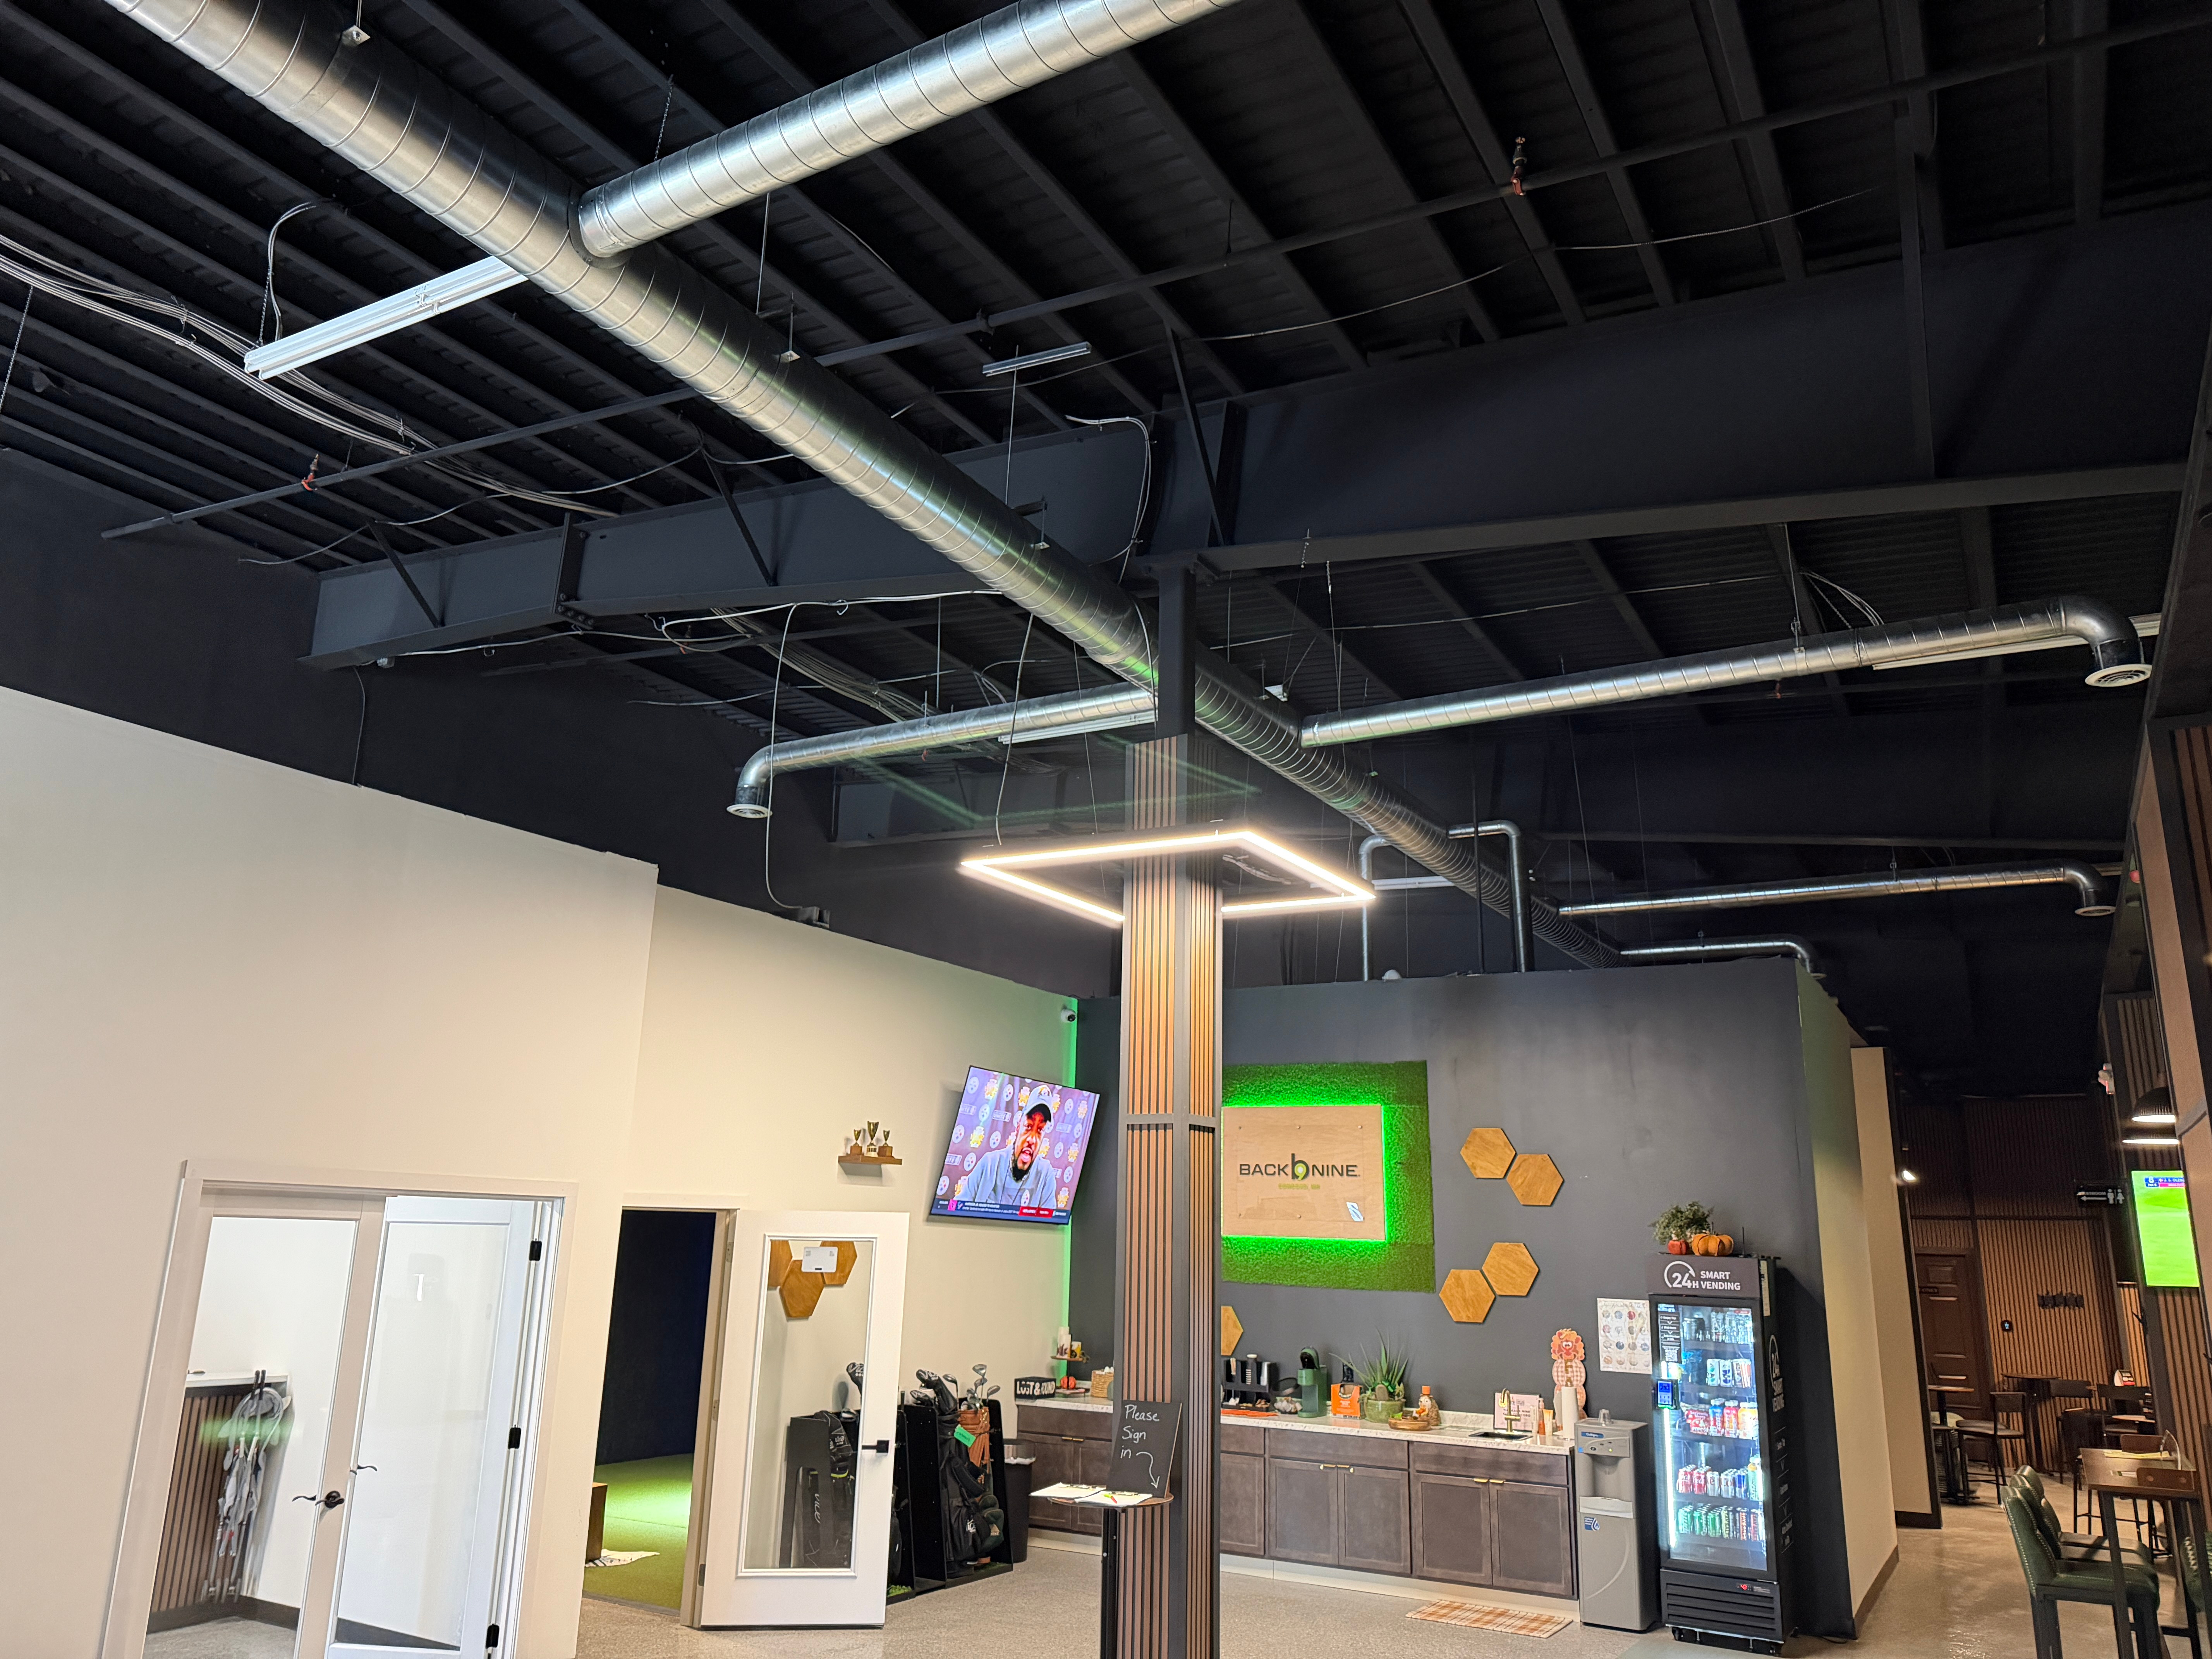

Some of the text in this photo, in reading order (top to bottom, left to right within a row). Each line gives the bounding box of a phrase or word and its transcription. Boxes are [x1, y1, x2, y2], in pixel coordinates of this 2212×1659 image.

[1239, 1164, 1289, 1176] BACK
[1700, 1271, 1731, 1280] SMART
[1700, 1281, 1741, 1291] VENDING
[1017, 1381, 1035, 1395] LOST
[1034, 1382, 1041, 1396] &
[1125, 1404, 1160, 1421] Please
[1122, 1425, 1146, 1443] Sign
[1120, 1445, 1132, 1458] in
